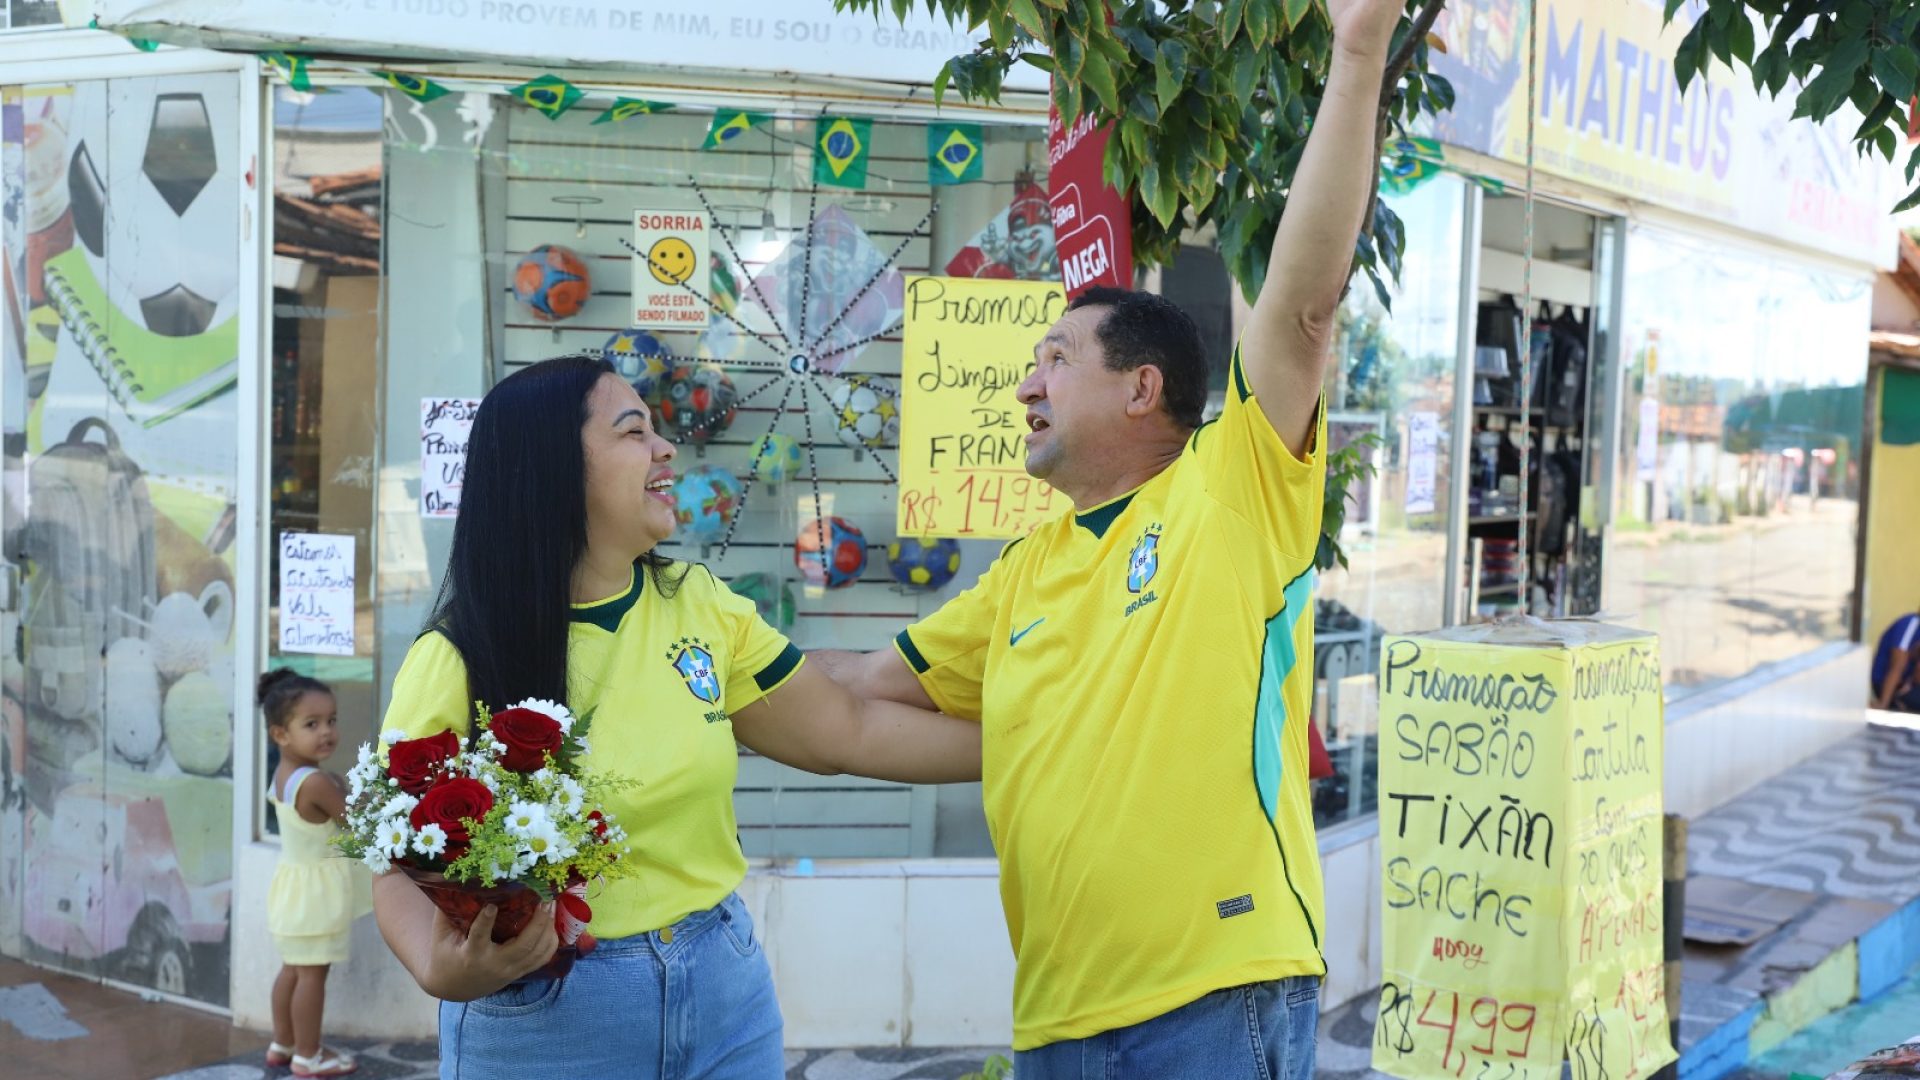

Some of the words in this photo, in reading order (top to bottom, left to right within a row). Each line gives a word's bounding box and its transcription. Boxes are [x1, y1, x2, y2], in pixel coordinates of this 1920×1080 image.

[480, 0, 598, 29] PROVEM
[608, 8, 644, 31] DE
[653, 12, 720, 40] MIM,
[730, 16, 764, 39] EU
[773, 19, 831, 44] SOU
[1540, 3, 1736, 182] MATHEUS
[639, 214, 704, 231] SORRIA
[1062, 237, 1110, 293] MEGA
[637, 309, 666, 321] SENDO
[668, 310, 705, 322] FILMADO
[971, 408, 1016, 429] DE
[929, 434, 1026, 468] FRAN
[902, 486, 942, 538] R$
[957, 474, 1054, 534] 14,99
[1124, 591, 1158, 617] BRASIL
[694, 669, 709, 679] CBF
[1416, 989, 1536, 1078] 4,99
